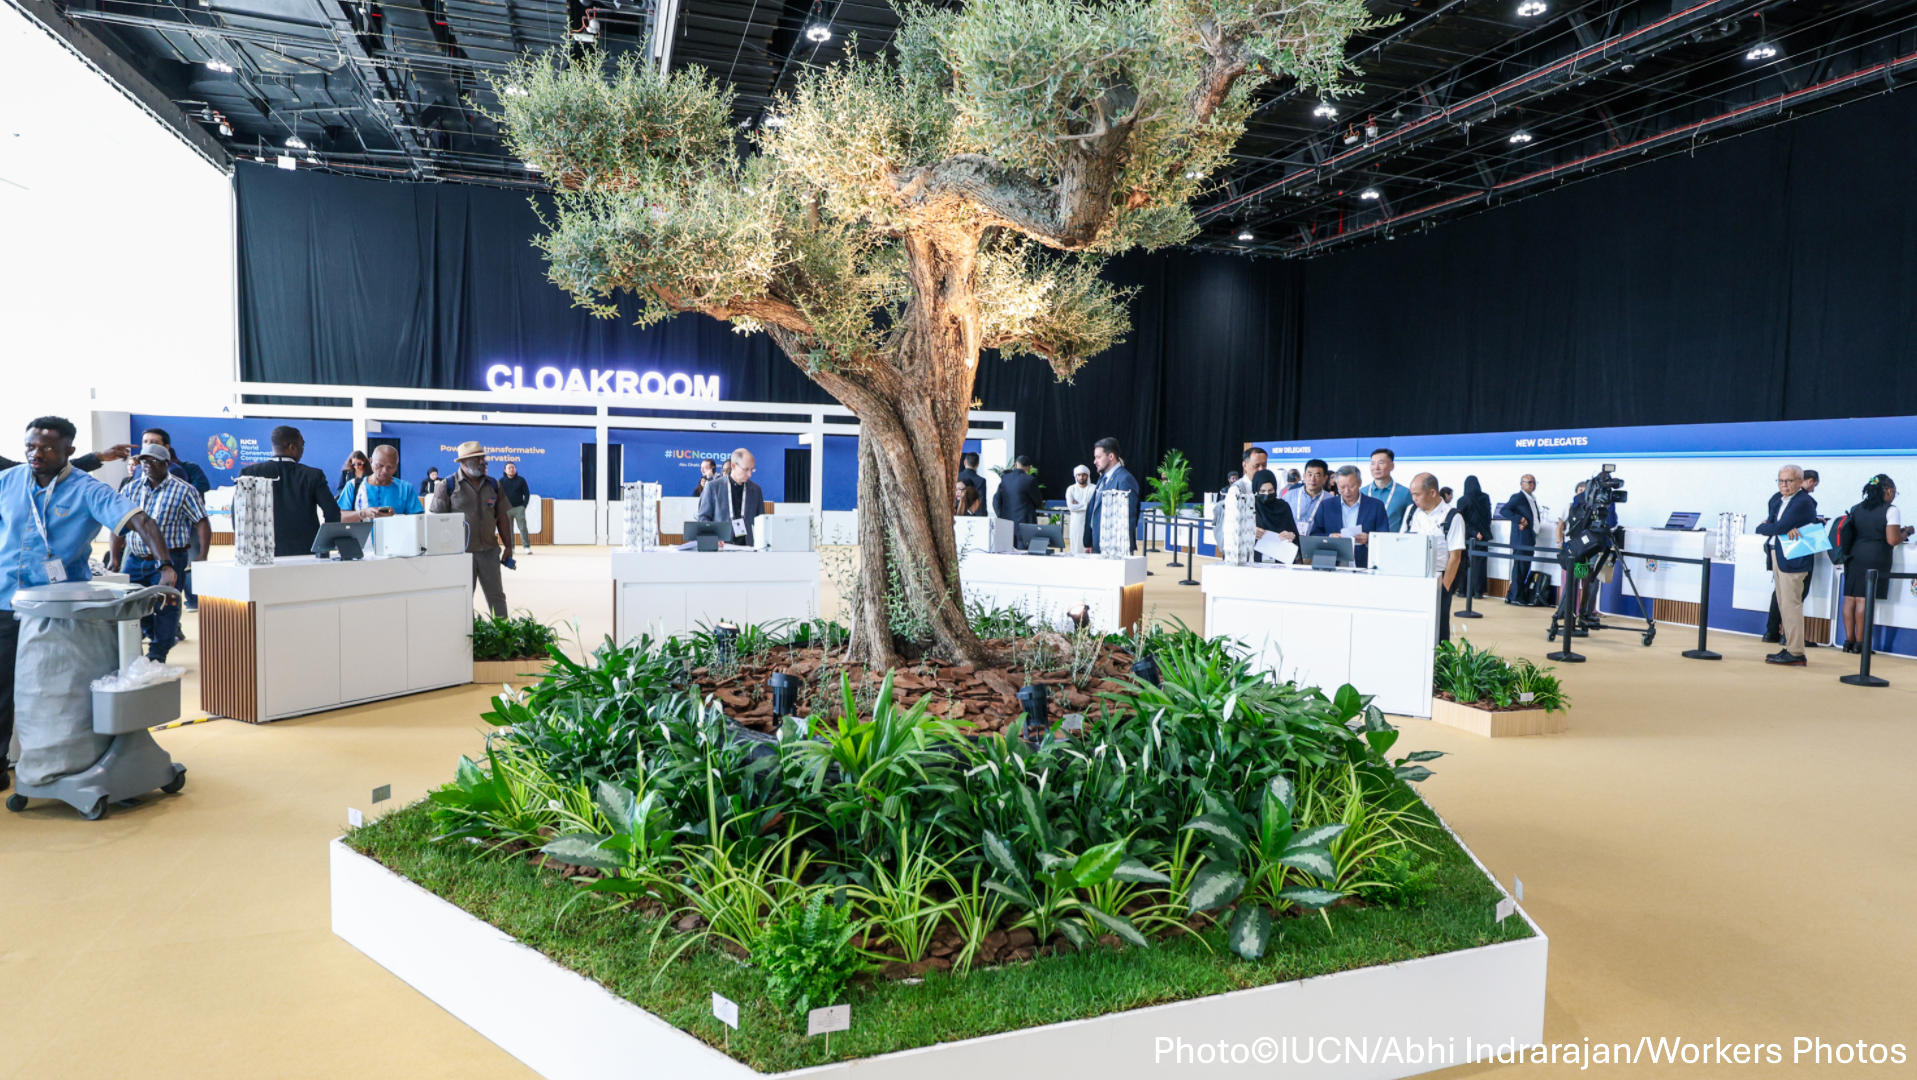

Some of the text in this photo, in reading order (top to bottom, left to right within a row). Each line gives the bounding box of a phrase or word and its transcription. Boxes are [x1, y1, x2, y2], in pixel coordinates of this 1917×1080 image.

[486, 364, 720, 402] CLOAKROOM
[1516, 436, 1588, 448] NEW DELEGATES
[483, 446, 546, 454] transformative
[664, 449, 732, 462] #IUCNcongr
[484, 454, 521, 462] ervation
